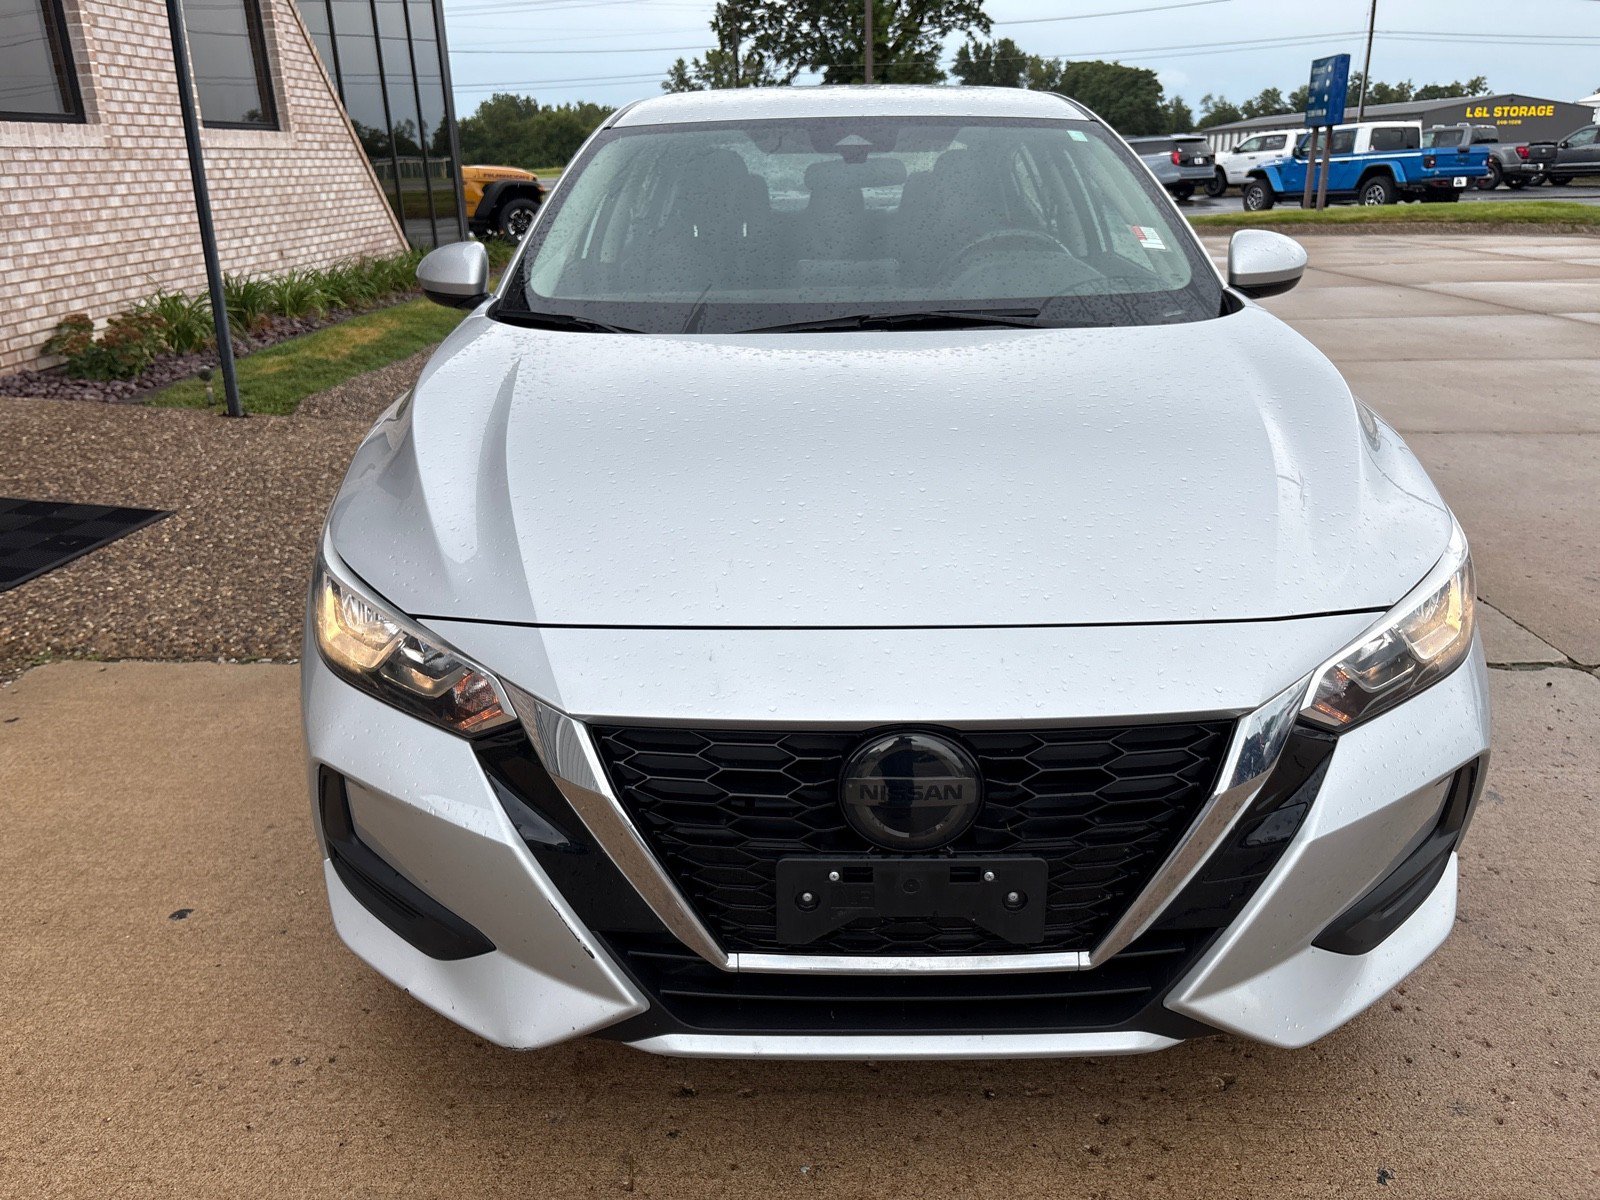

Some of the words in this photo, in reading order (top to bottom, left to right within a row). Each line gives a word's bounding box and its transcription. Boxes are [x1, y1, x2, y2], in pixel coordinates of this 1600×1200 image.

[1466, 106, 1490, 118] L&L
[1493, 105, 1555, 118] STORAGE
[859, 784, 963, 801] NISSAN
